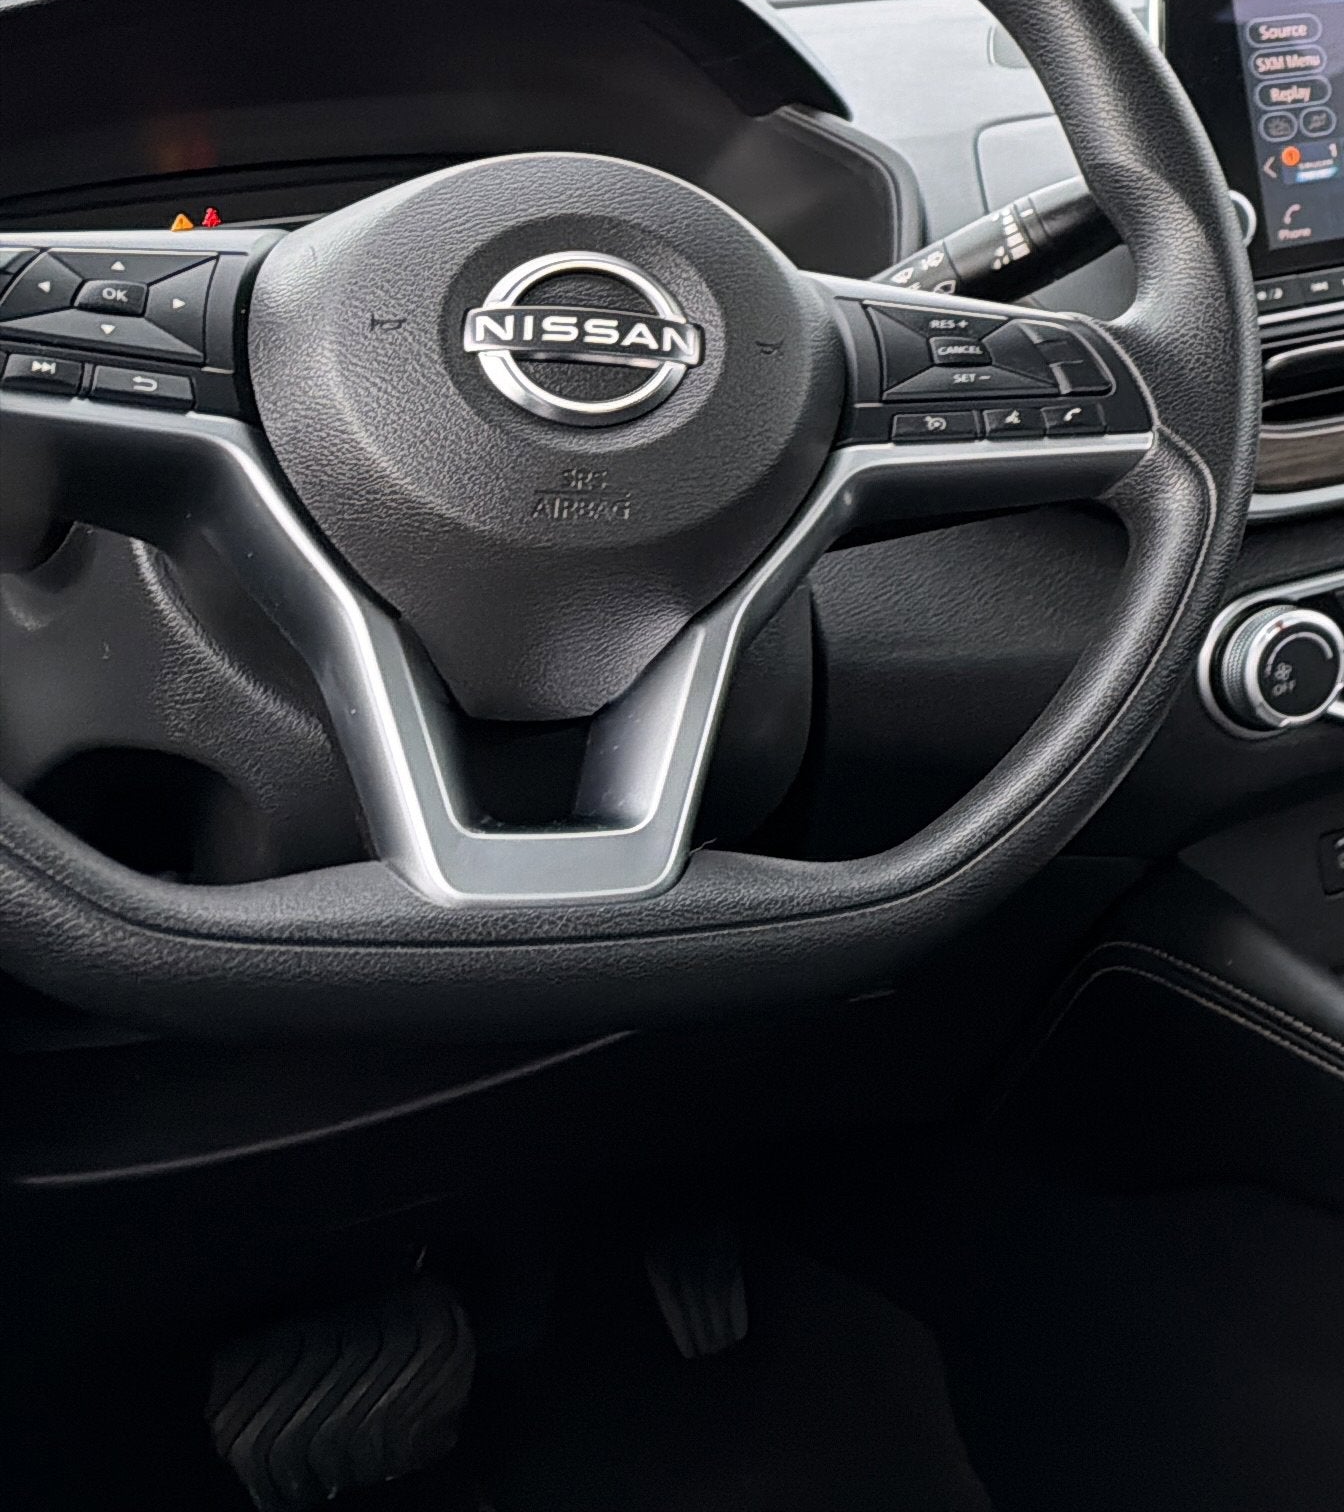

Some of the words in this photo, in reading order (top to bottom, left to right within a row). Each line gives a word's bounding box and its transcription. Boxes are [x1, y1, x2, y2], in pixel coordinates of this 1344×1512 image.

[1259, 24, 1308, 40] Source
[1256, 56, 1285, 72] SXM
[1286, 54, 1321, 68] Menu
[1269, 85, 1312, 103] Replay
[1278, 227, 1312, 240] Phone
[102, 287, 129, 303] OK
[929, 319, 955, 329] RES
[474, 314, 698, 358] NISSAN
[938, 345, 983, 355] CANCEL
[953, 373, 976, 384] SET
[532, 494, 632, 520] AIRBAG
[1271, 680, 1296, 697] OFF
